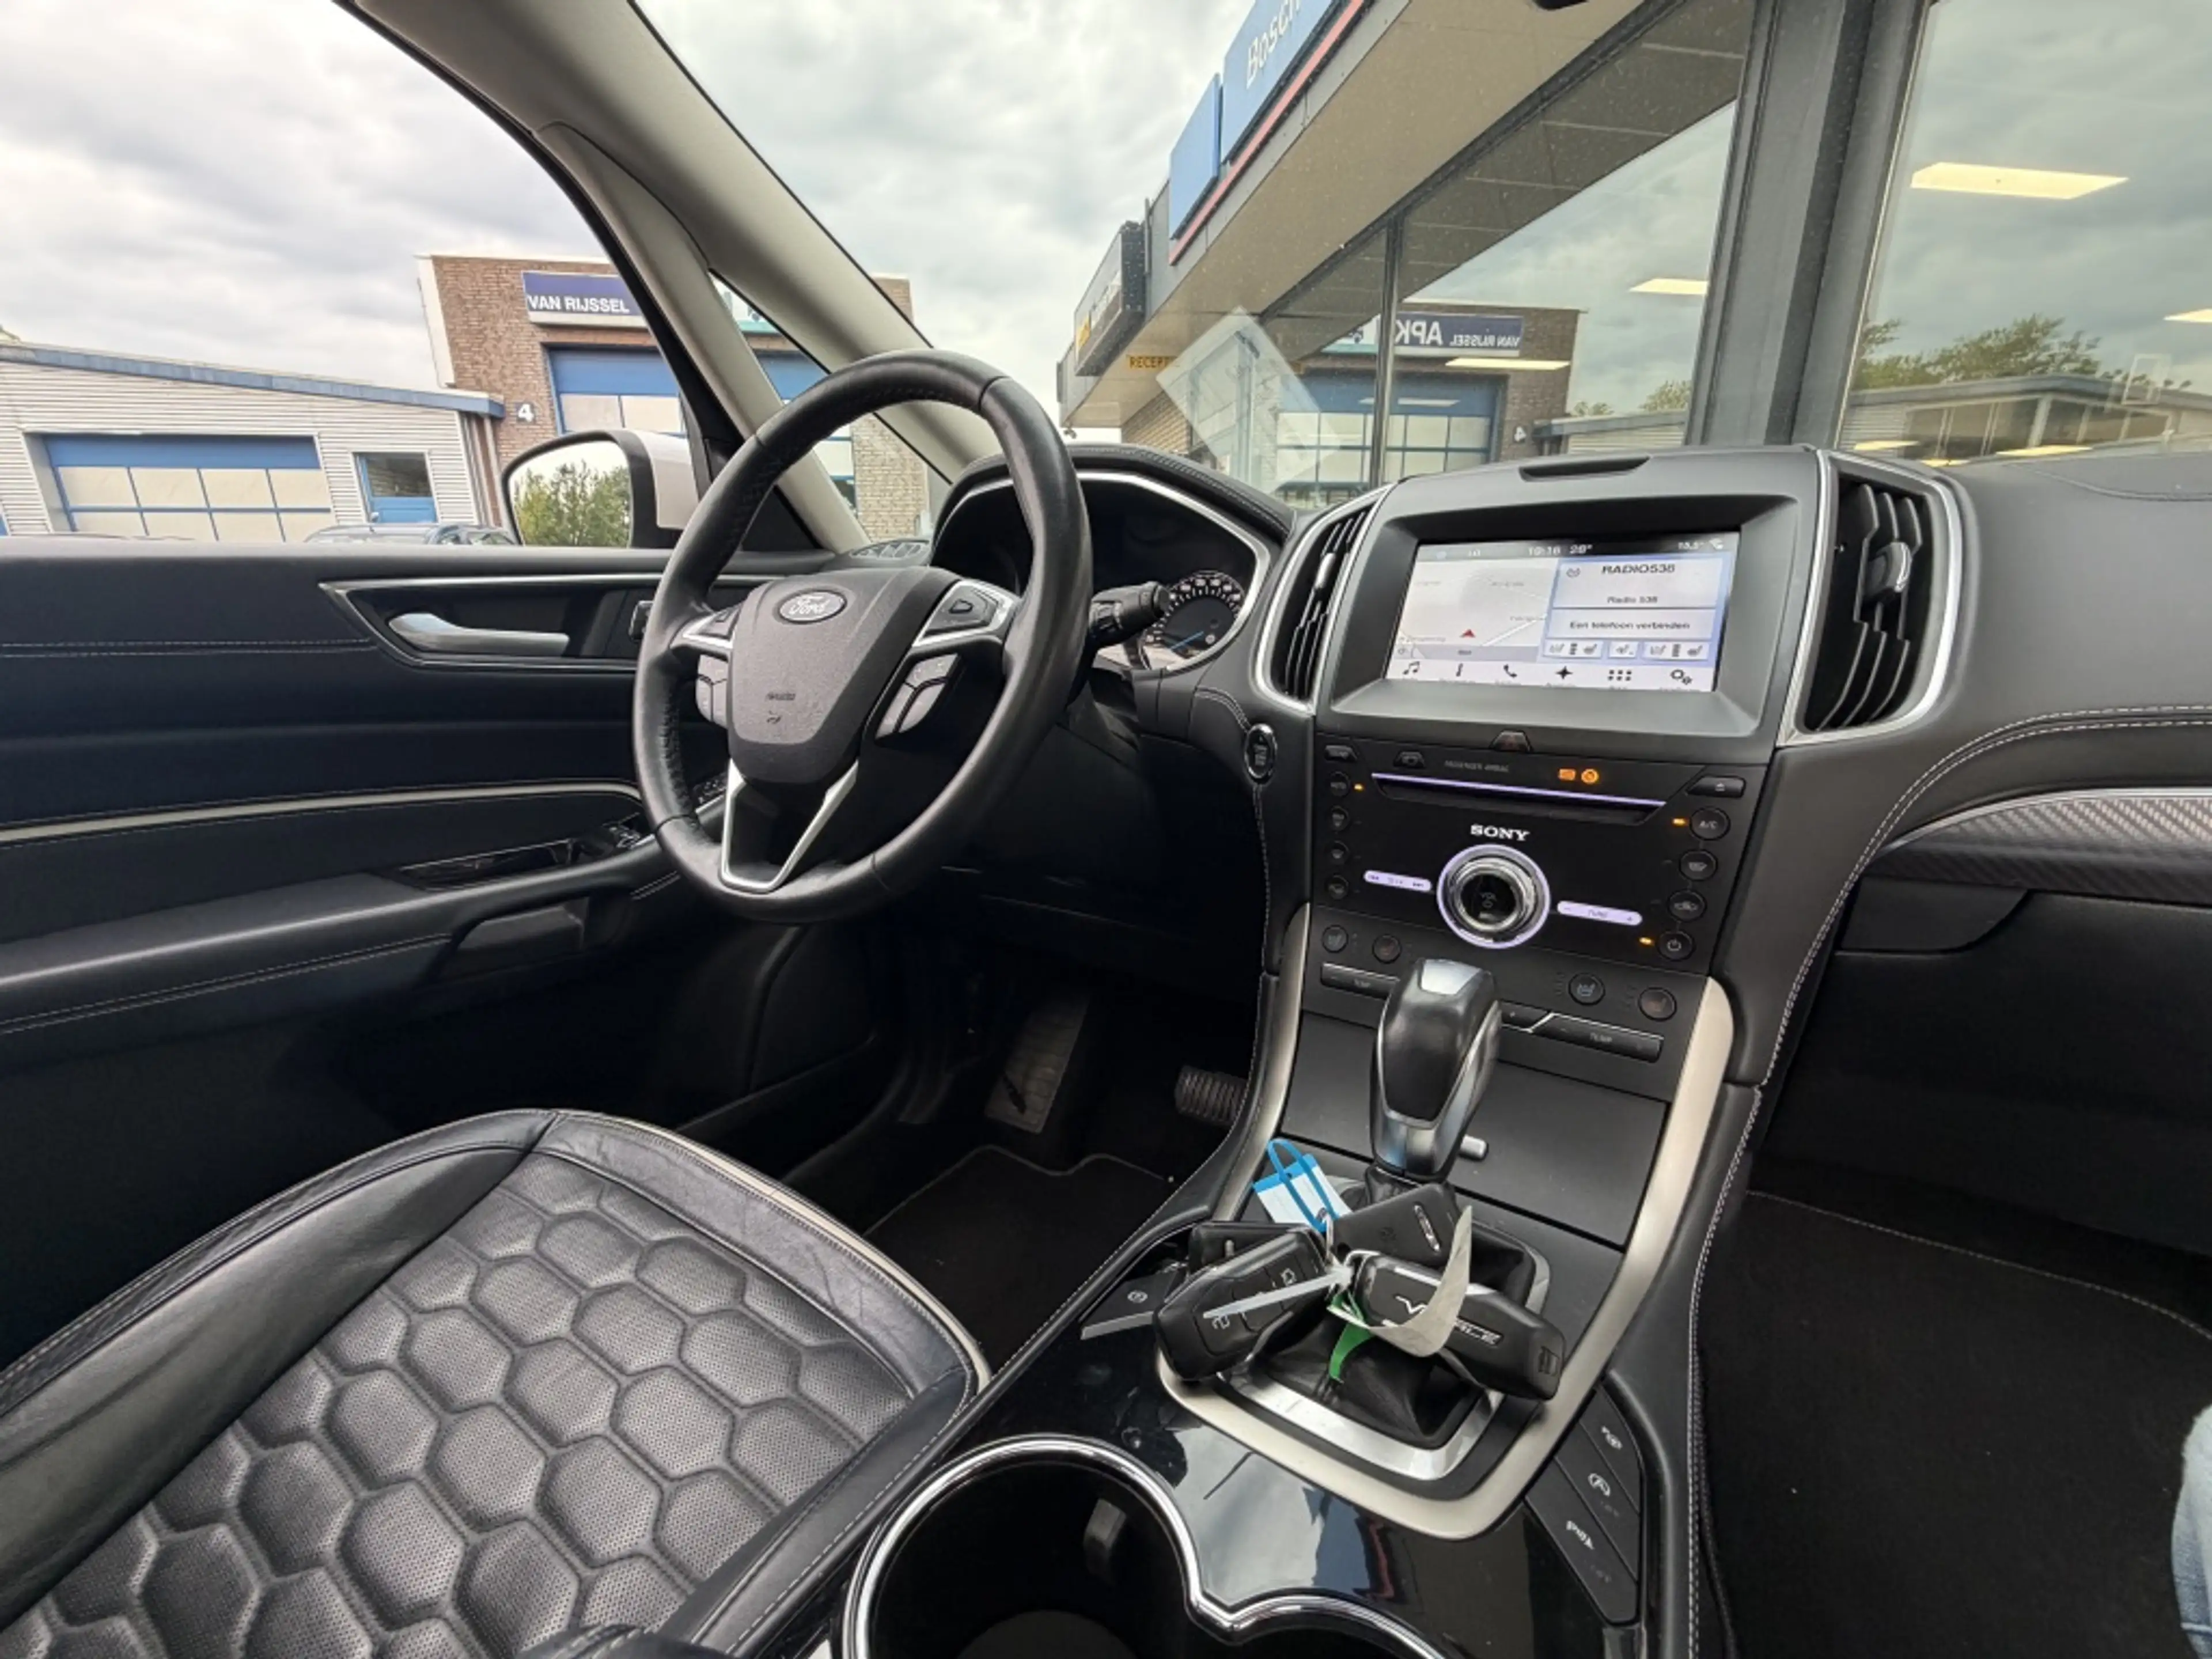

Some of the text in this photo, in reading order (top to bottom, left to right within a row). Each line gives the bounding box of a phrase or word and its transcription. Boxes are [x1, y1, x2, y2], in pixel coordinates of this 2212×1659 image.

[527, 294, 630, 313] VAN RIJSSEL
[518, 404, 535, 422] 4
[787, 595, 831, 615] Ford
[1470, 823, 1531, 842] SONY
